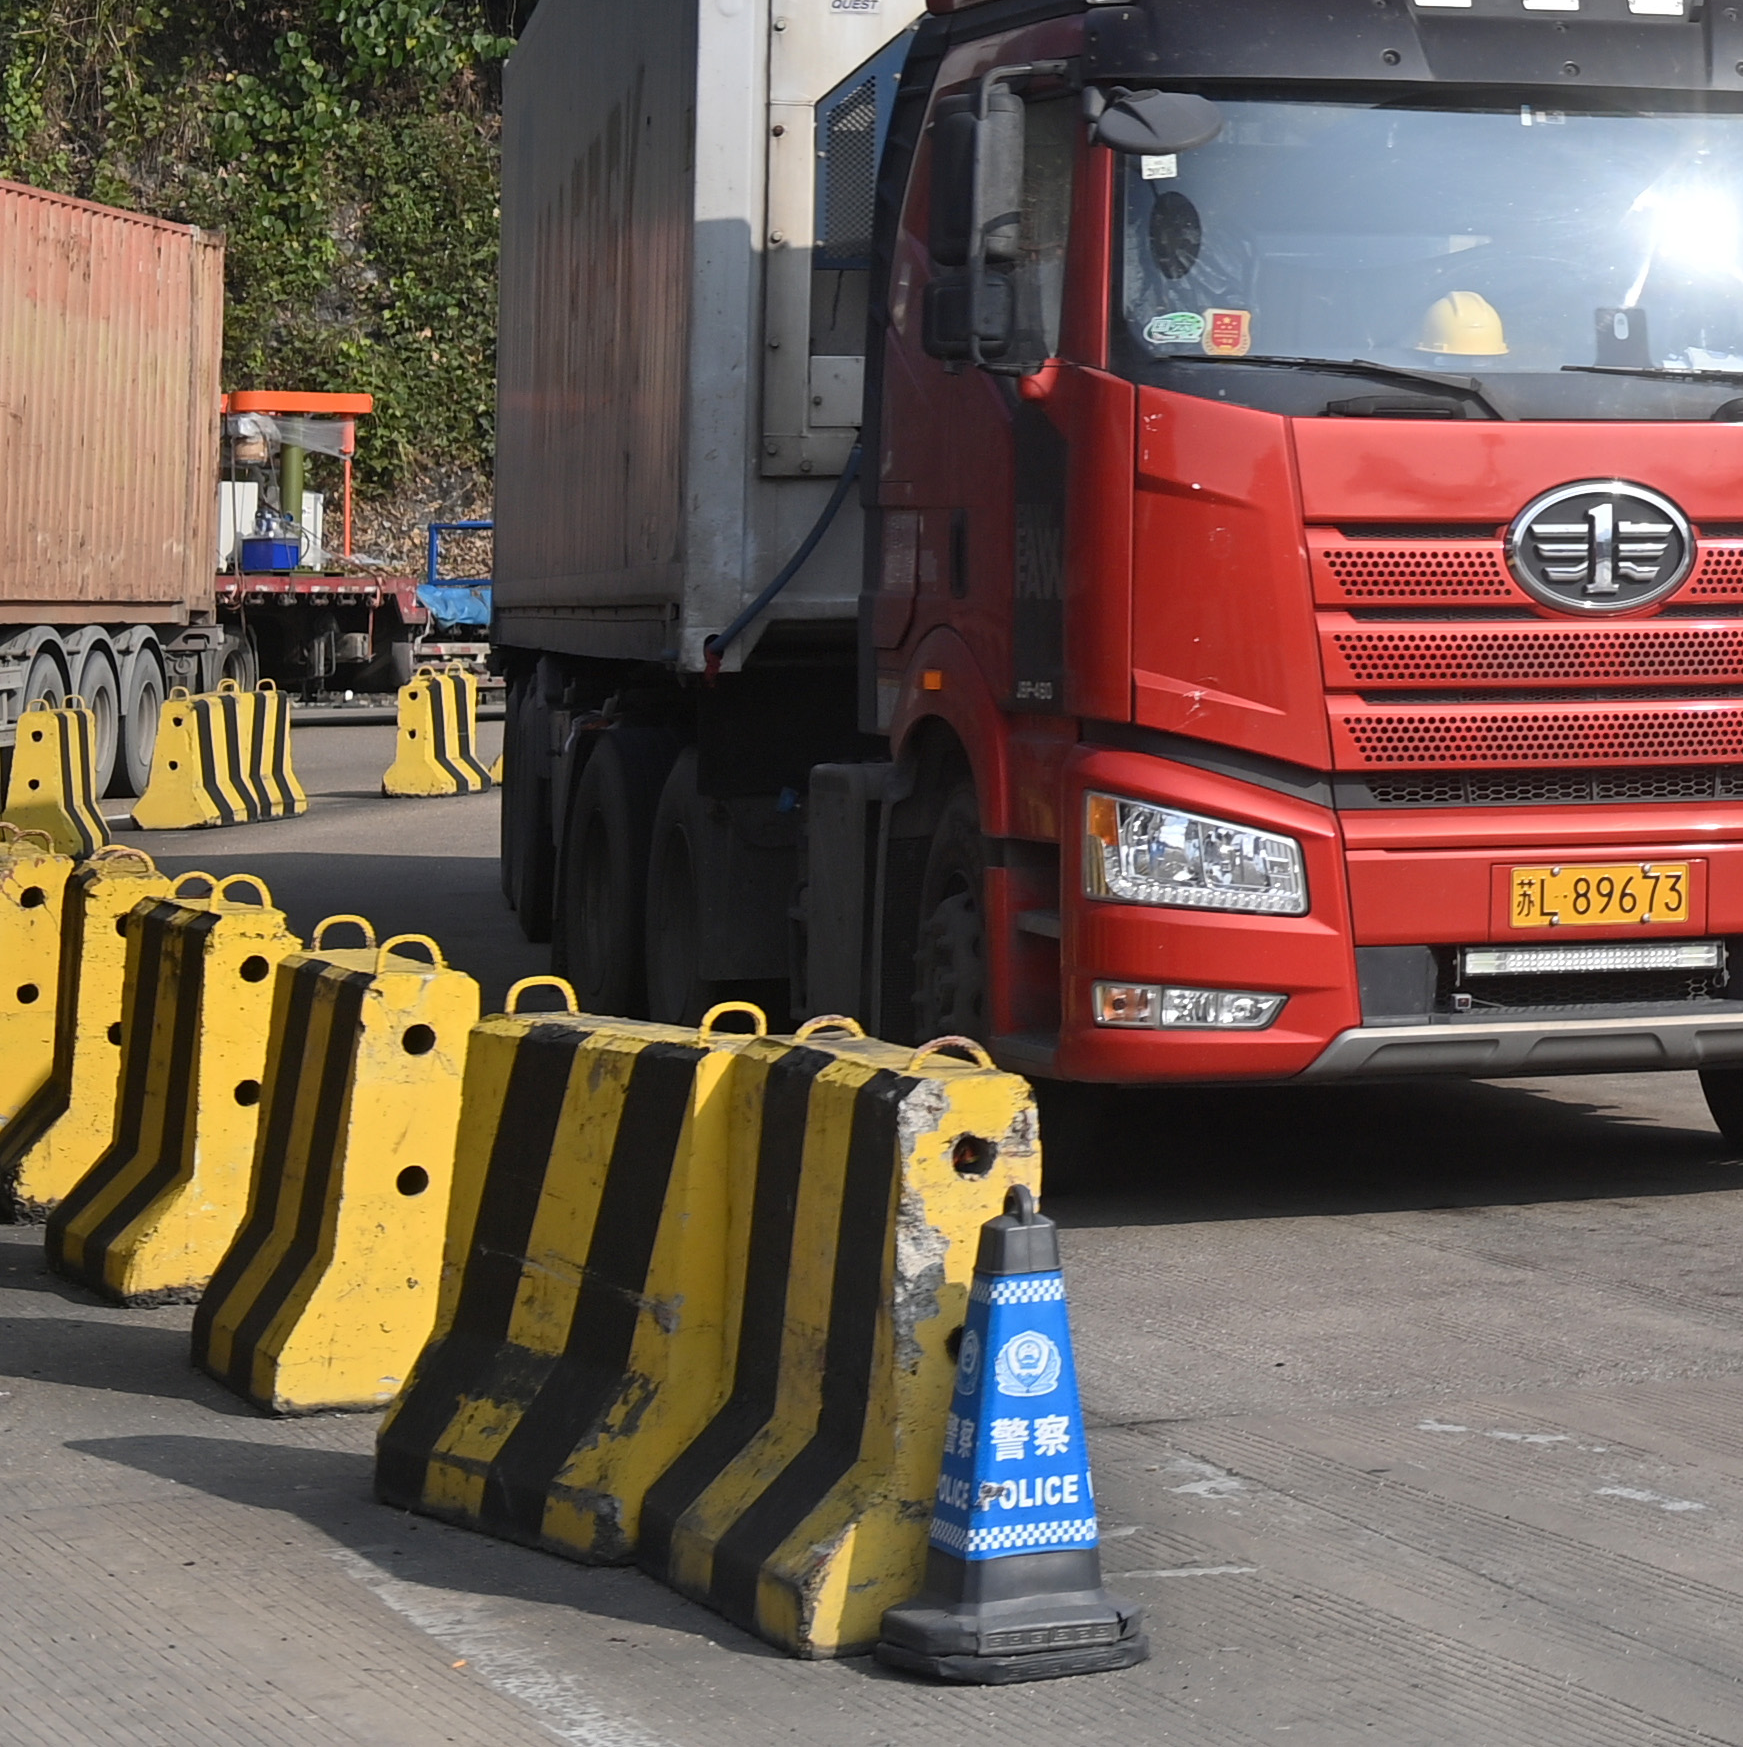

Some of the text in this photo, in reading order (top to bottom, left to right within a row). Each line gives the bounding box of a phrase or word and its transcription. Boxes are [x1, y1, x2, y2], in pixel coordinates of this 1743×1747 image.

[943, 1411, 976, 1458] 警察
[989, 1414, 1071, 1462] 警察
[977, 1474, 1080, 1512] POLICE
